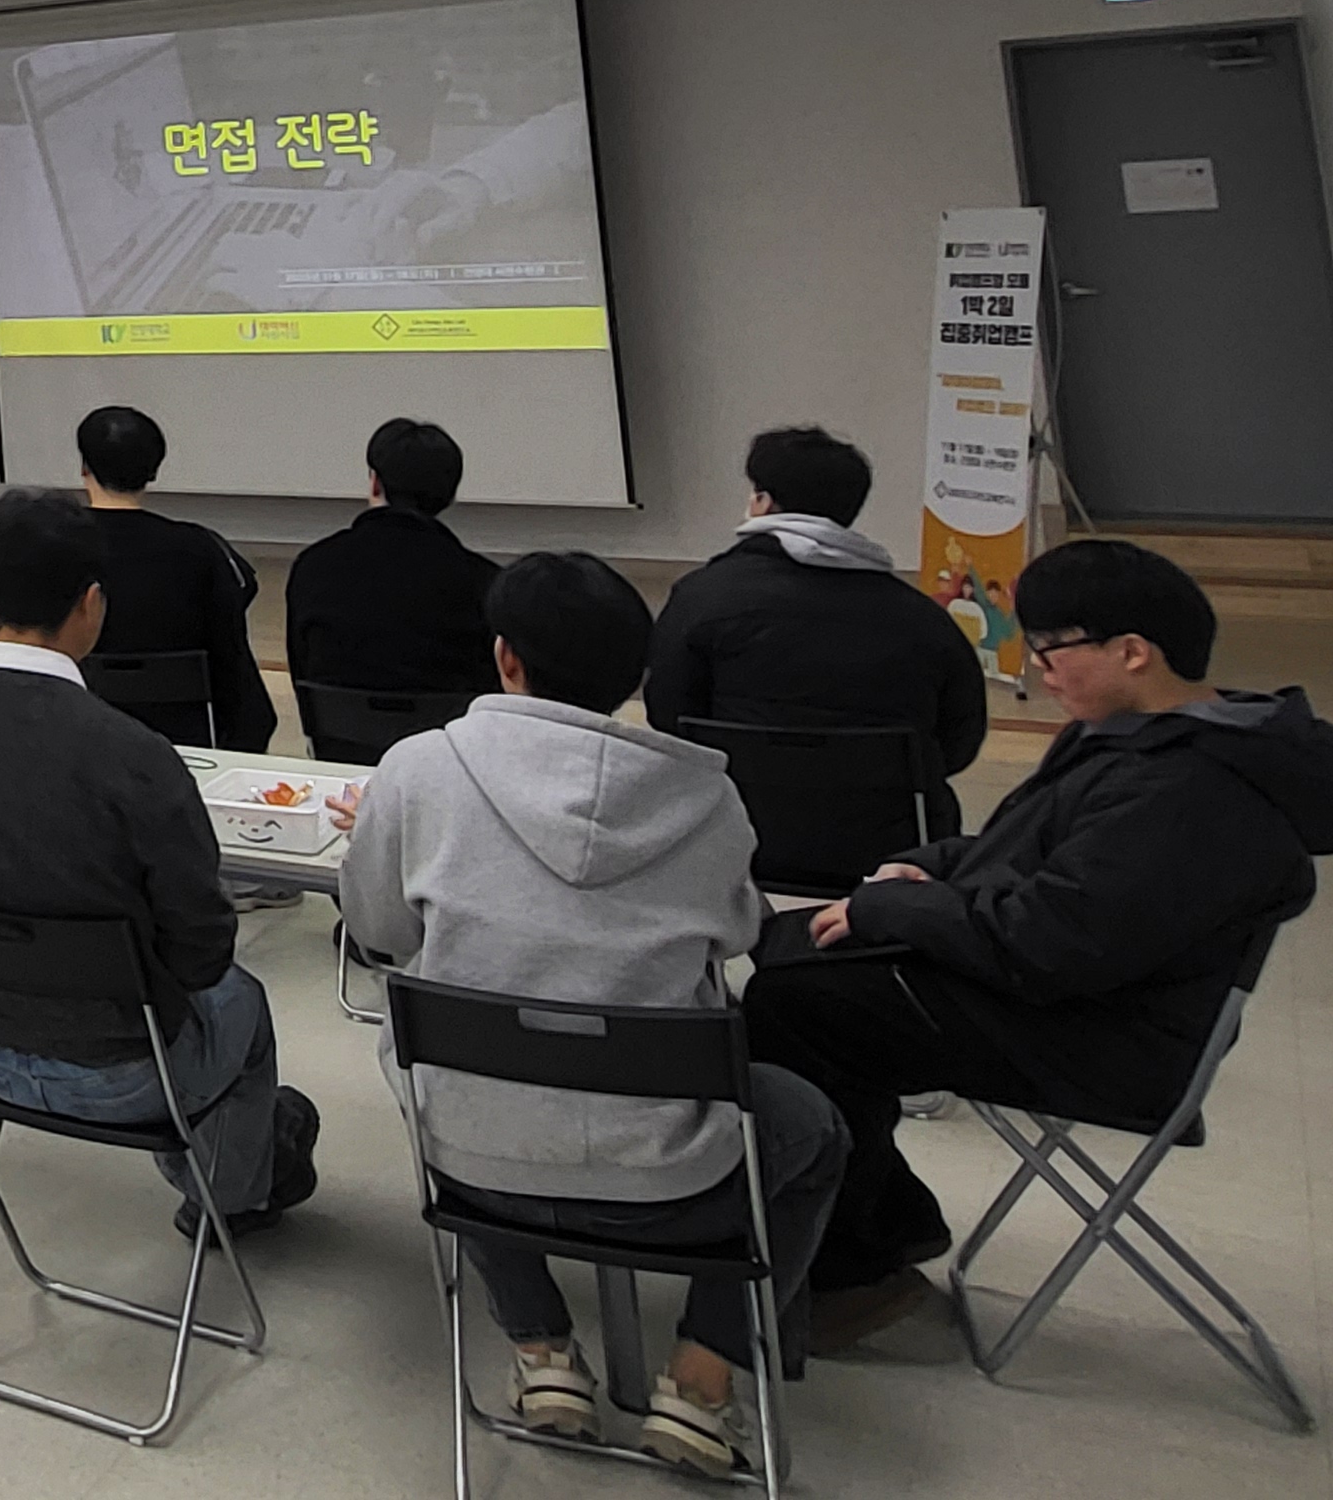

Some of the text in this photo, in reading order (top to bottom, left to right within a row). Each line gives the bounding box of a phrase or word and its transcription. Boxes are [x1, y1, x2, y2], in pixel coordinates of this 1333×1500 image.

[163, 110, 380, 176] 면접 전략
[960, 295, 1014, 317] 1박 2일
